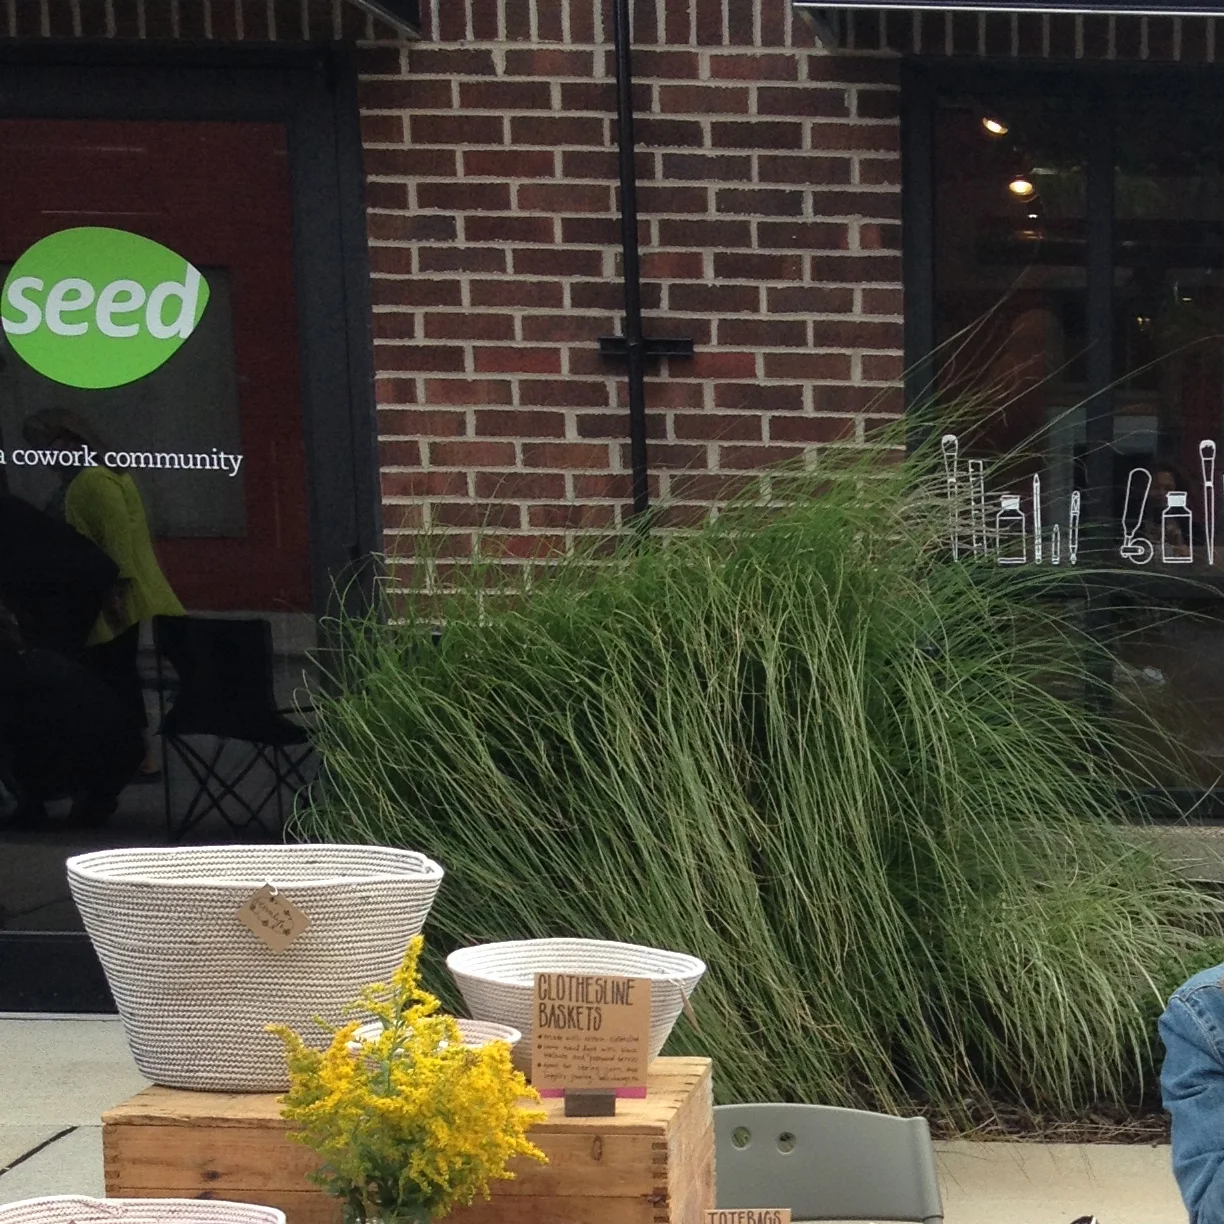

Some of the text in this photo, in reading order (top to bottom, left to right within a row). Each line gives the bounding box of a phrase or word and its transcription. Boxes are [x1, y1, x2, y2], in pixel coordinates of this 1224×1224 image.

[1, 261, 201, 339] seed
[12, 445, 98, 467] cowork
[104, 448, 243, 477] community
[538, 974, 635, 1006] CLOTHESLINE
[539, 1002, 603, 1031] BASKETS
